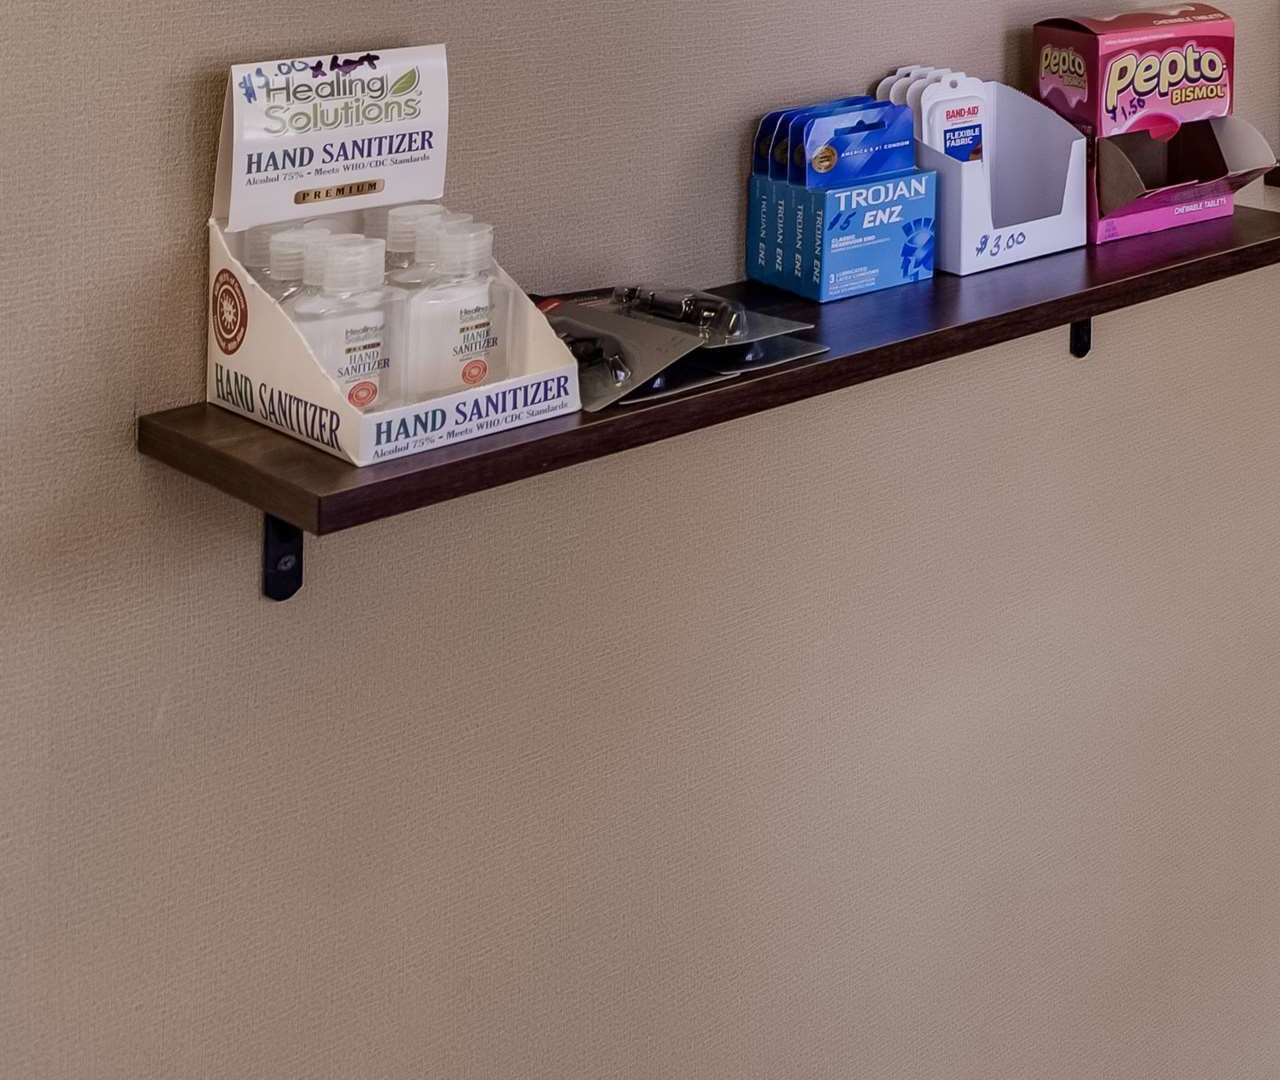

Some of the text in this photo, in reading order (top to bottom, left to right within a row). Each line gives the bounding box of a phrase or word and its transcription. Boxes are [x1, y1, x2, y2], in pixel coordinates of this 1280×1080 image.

[1041, 44, 1086, 80] Pepto
[265, 70, 387, 104] Healing
[1105, 44, 1224, 113] Pepto
[1171, 84, 1225, 106] BISMOL
[263, 97, 421, 136] Solutions
[945, 105, 980, 121] BAND-AID
[946, 126, 980, 141] FLEXIBLE
[946, 136, 974, 149] FABRIC
[245, 129, 434, 176] HAND SANITIZER
[245, 154, 431, 186] Alcohol 75% Meets WHO/CDC Standards
[301, 181, 379, 202] PREMIUM
[835, 177, 927, 211] TROJAN
[863, 205, 903, 229] ENZ
[1174, 196, 1227, 216] CHEWABLE TABLETS
[974, 231, 1027, 258] $3.00
[812, 259, 821, 285] ENZ
[349, 350, 380, 366] HAND
[451, 336, 499, 357] SANITIZER
[337, 358, 391, 378] SANITIZER
[214, 362, 342, 453] HAND SANITIZER
[373, 373, 571, 447] HAND SANITIZER
[372, 442, 410, 460] Alcohol
[445, 425, 474, 441] Meets
[475, 412, 525, 434] WHO/CDC
